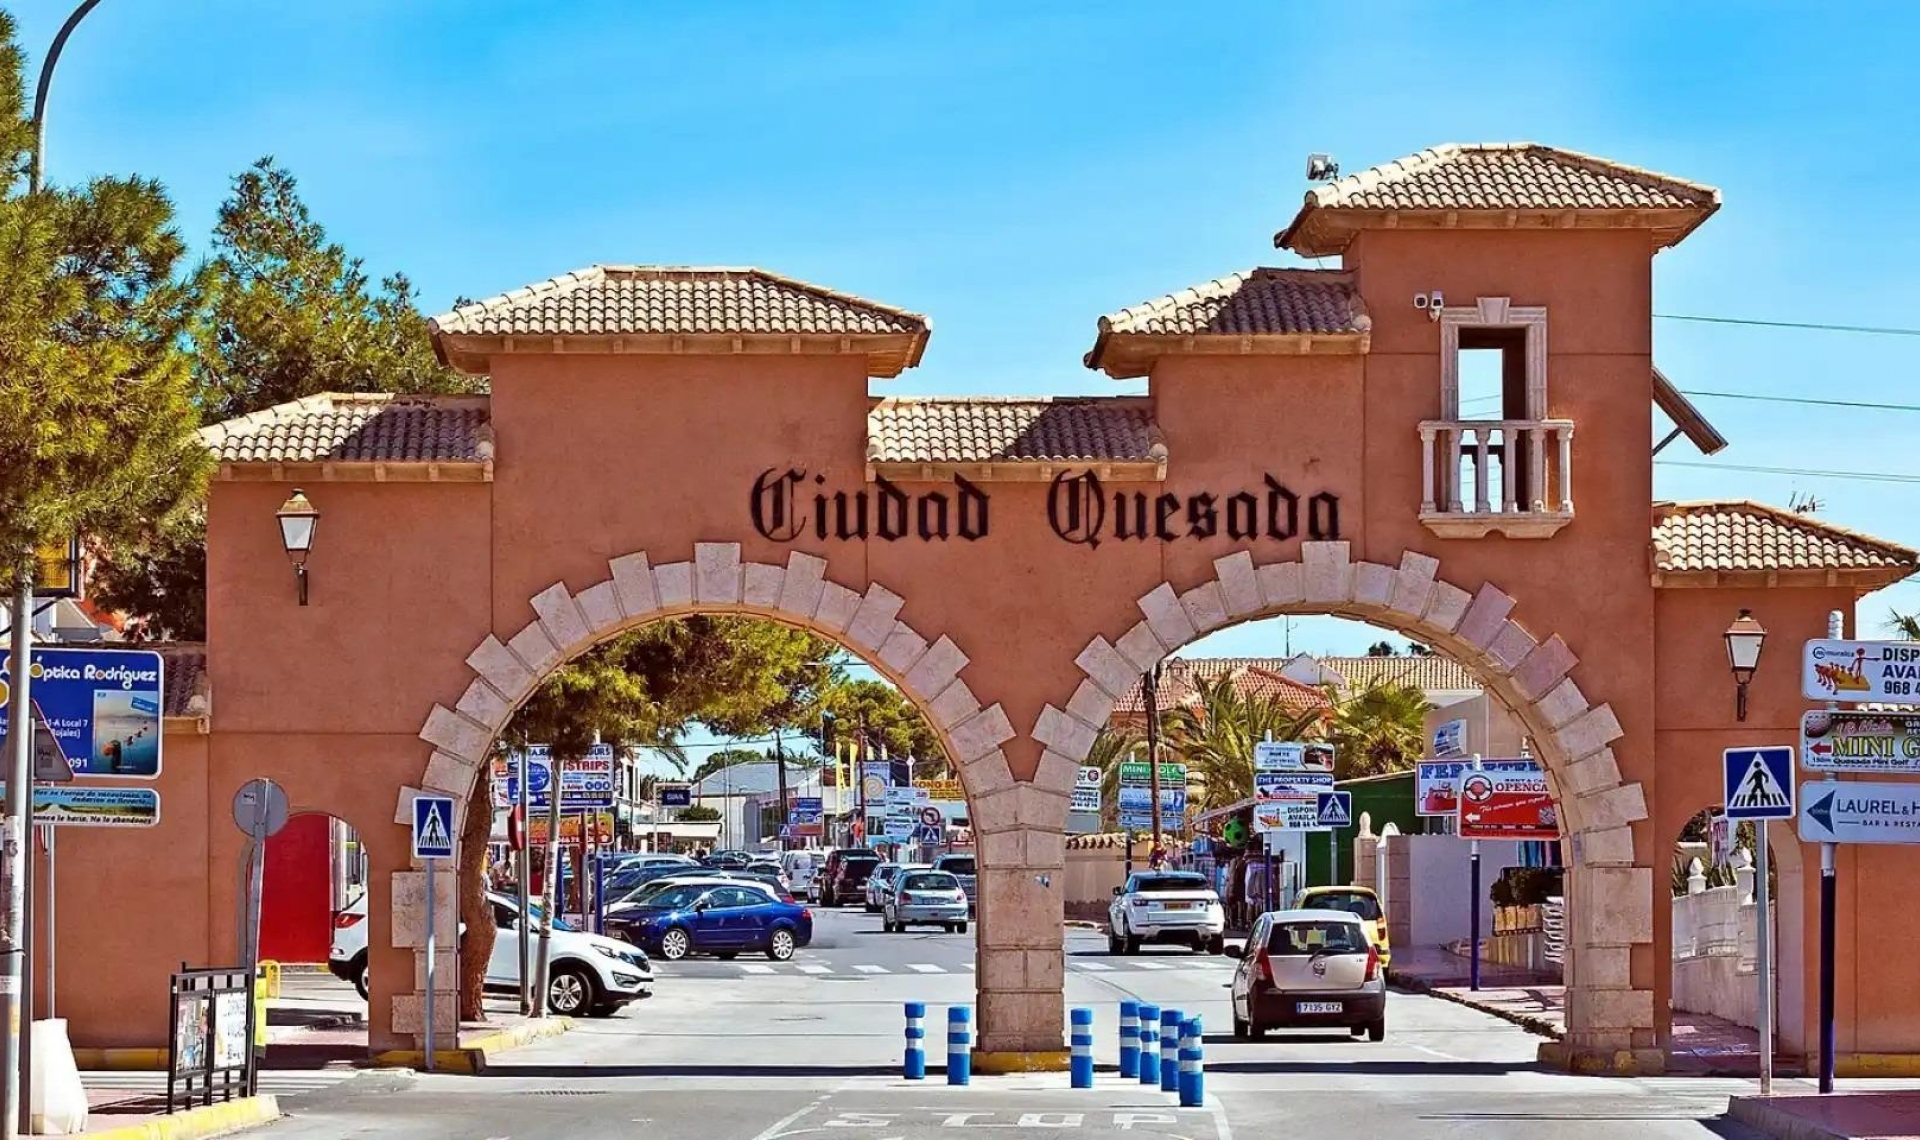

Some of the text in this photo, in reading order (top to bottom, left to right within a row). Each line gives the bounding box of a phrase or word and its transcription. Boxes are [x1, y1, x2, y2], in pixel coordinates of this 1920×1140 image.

[749, 467, 1341, 551] Ciudad Quesada
[1882, 647, 1920, 662] DISP
[30, 655, 158, 690] Óptica Rodríguez
[1884, 681, 1911, 695] 968
[62, 718, 82, 728] Local
[1831, 735, 1896, 757] MINI
[1312, 777, 1332, 785] SHOP
[1837, 798, 1900, 815] LAUREL
[1901, 804, 1910, 815] &
[822, 1112, 1178, 1131] STOP
